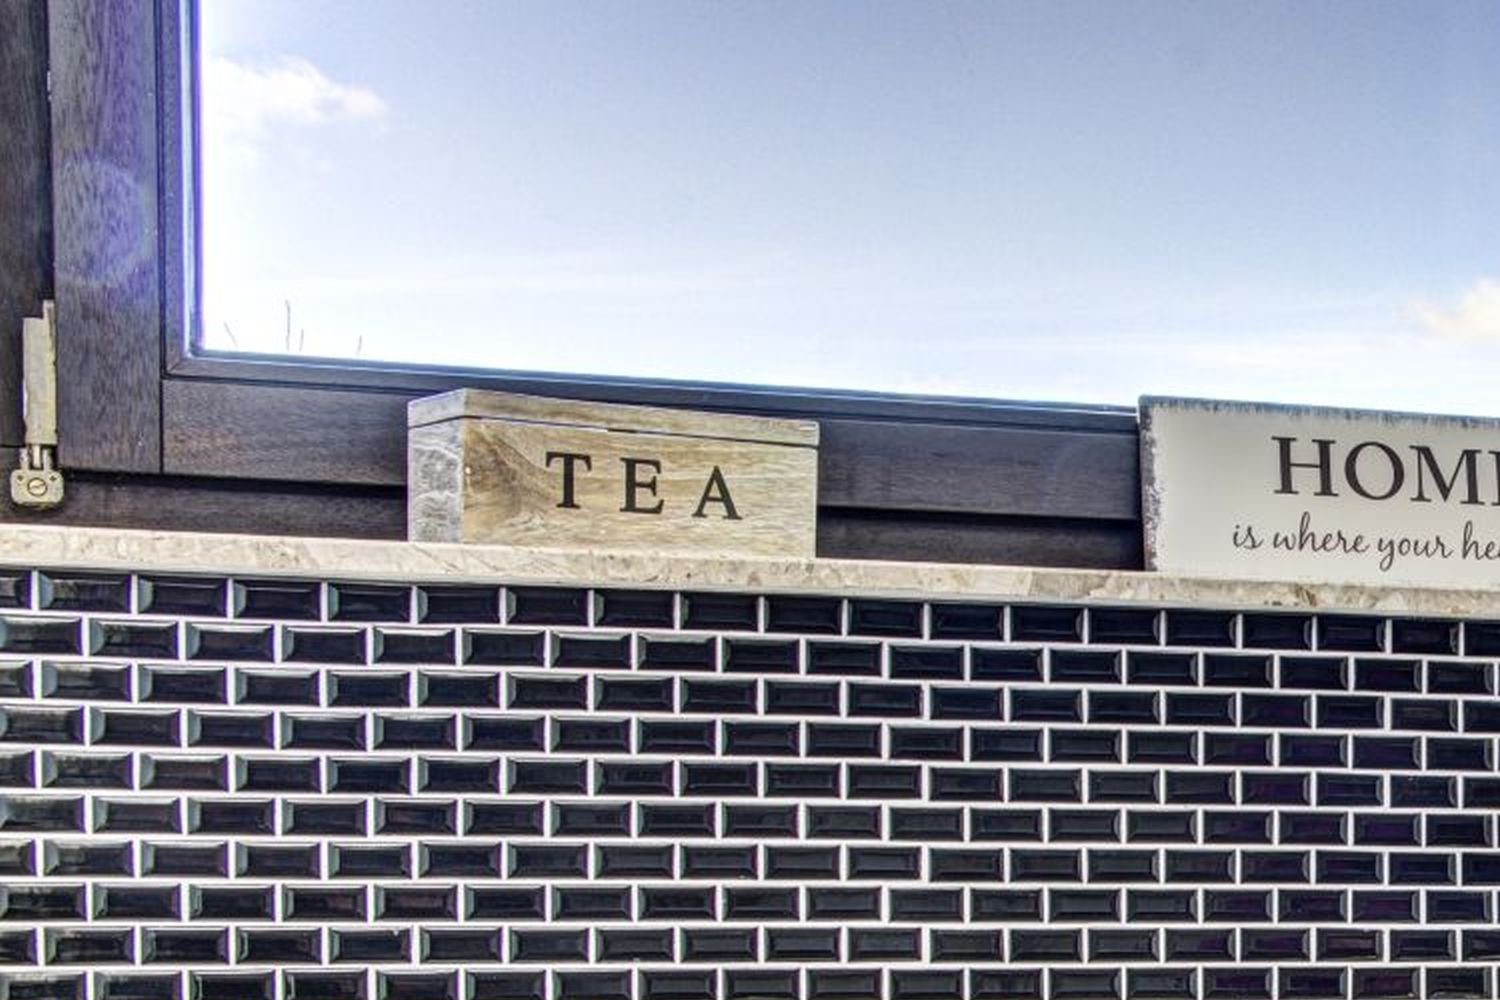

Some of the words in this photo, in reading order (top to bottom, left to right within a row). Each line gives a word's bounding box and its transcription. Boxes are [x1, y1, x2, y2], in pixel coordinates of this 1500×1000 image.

[546, 451, 743, 520] TEA
[1233, 523, 1263, 550] is
[1273, 511, 1371, 553] where
[1377, 530, 1454, 572] your
